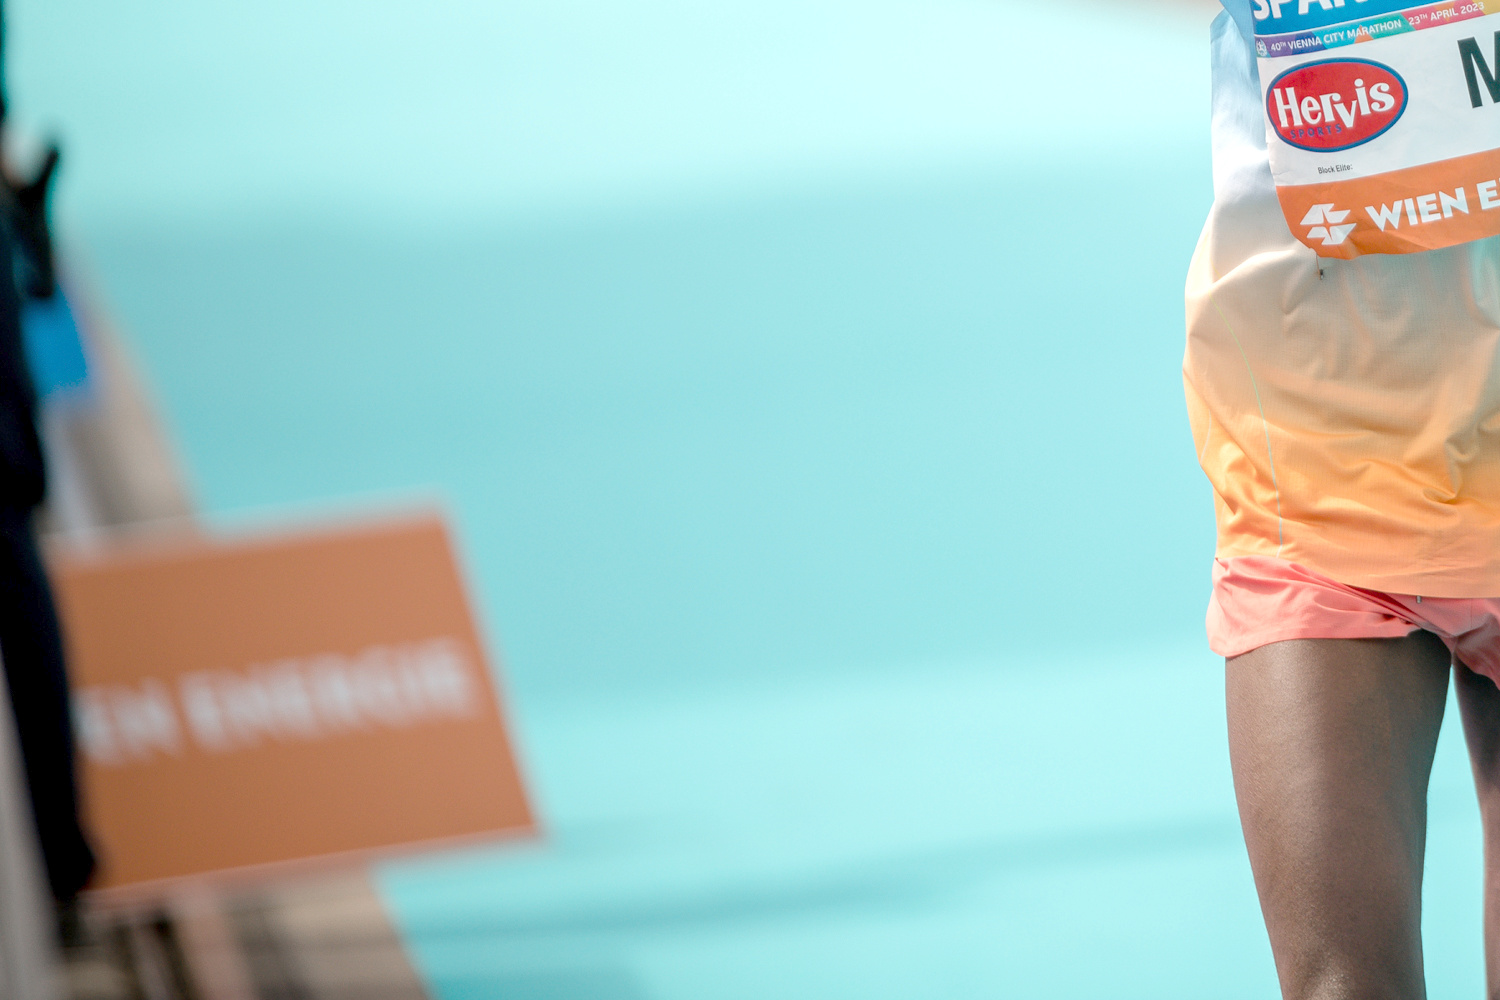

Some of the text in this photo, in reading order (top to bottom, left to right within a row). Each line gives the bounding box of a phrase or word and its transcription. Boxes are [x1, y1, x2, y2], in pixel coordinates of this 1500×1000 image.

[1287, 36, 1323, 50] VIENNA
[1323, 30, 1345, 44] CITY
[1346, 18, 1402, 40] MARATHON
[1430, 7, 1459, 21] APRIL
[1460, 1, 1485, 15] 2023
[1273, 78, 1396, 129] Hervis
[1289, 123, 1343, 140] SPORTS
[1317, 165, 1336, 175] Block
[1364, 187, 1469, 232] WIEN
